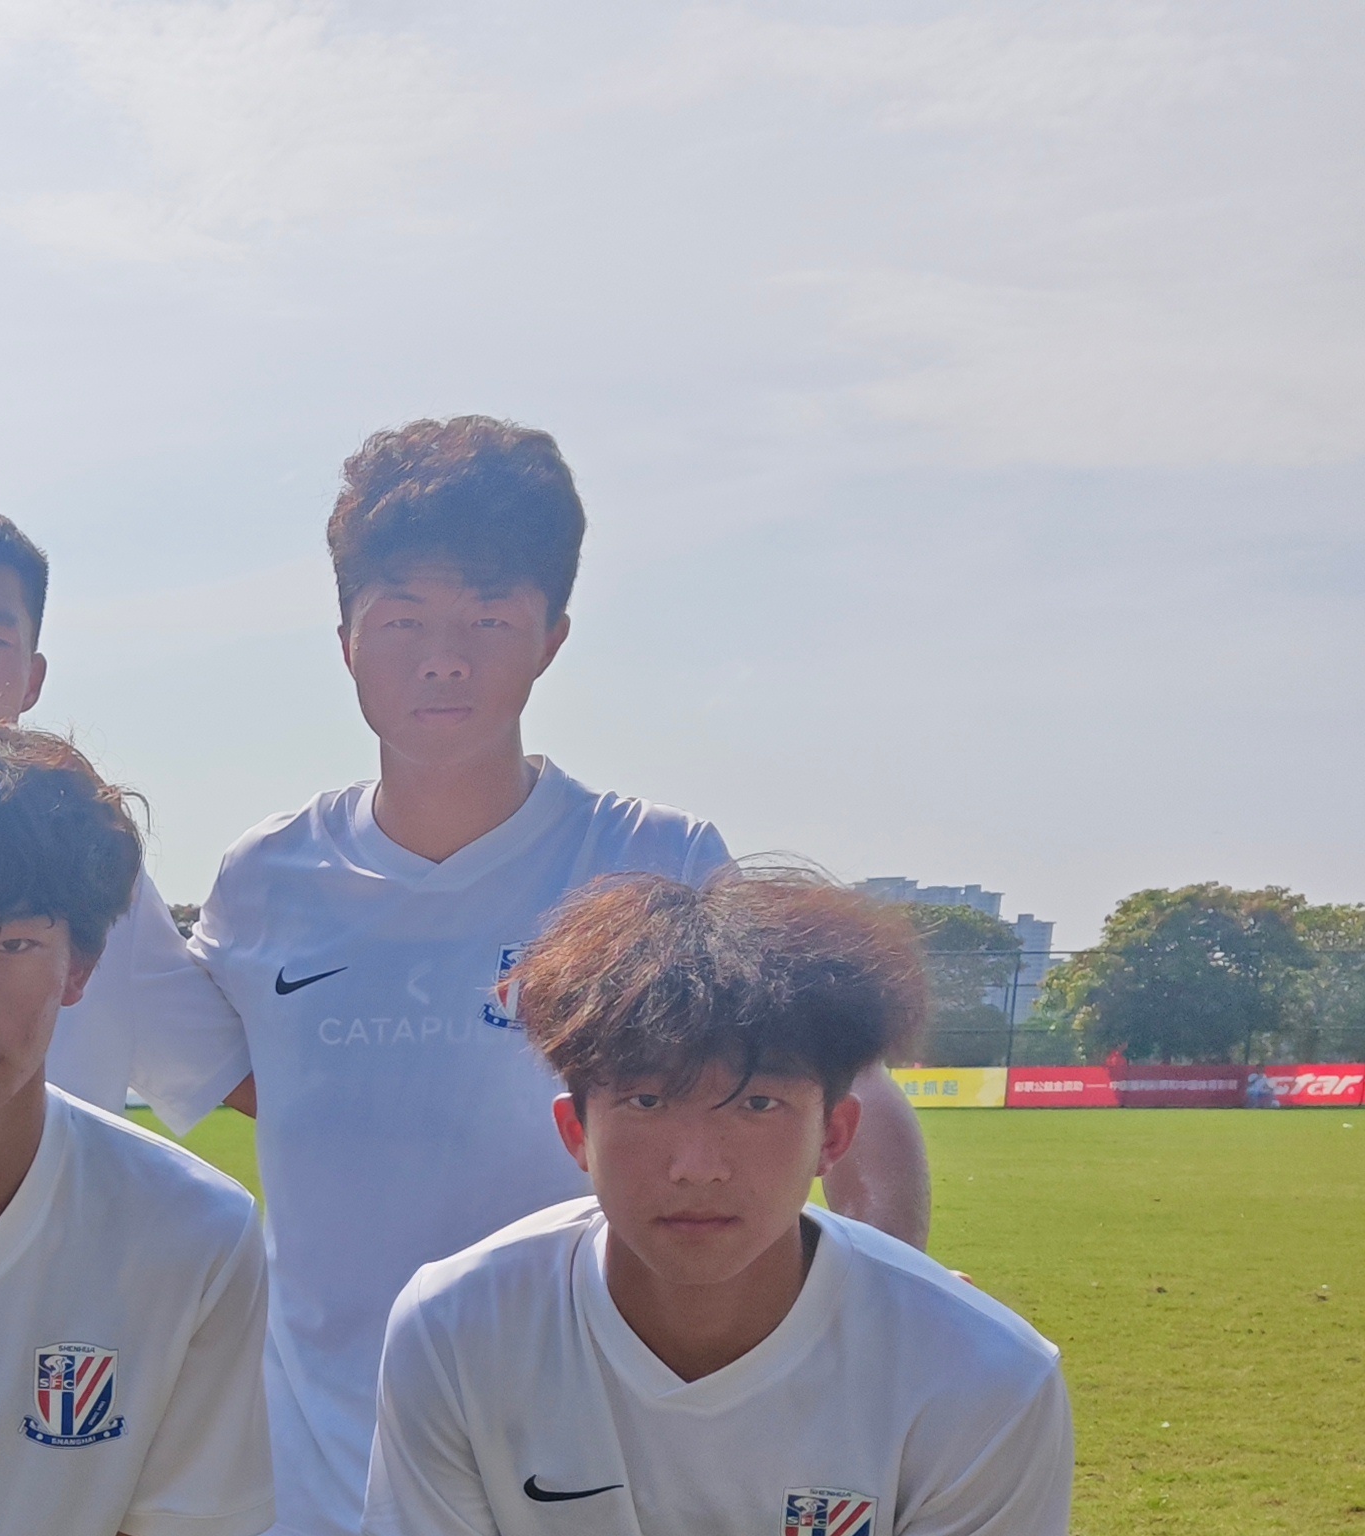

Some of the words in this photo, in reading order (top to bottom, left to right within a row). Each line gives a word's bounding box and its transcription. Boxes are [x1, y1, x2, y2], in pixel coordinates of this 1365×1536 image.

[39, 1378, 75, 1390] SFC
[51, 1435, 96, 1446] SHANGHAI
[786, 1516, 828, 1528] SFC
